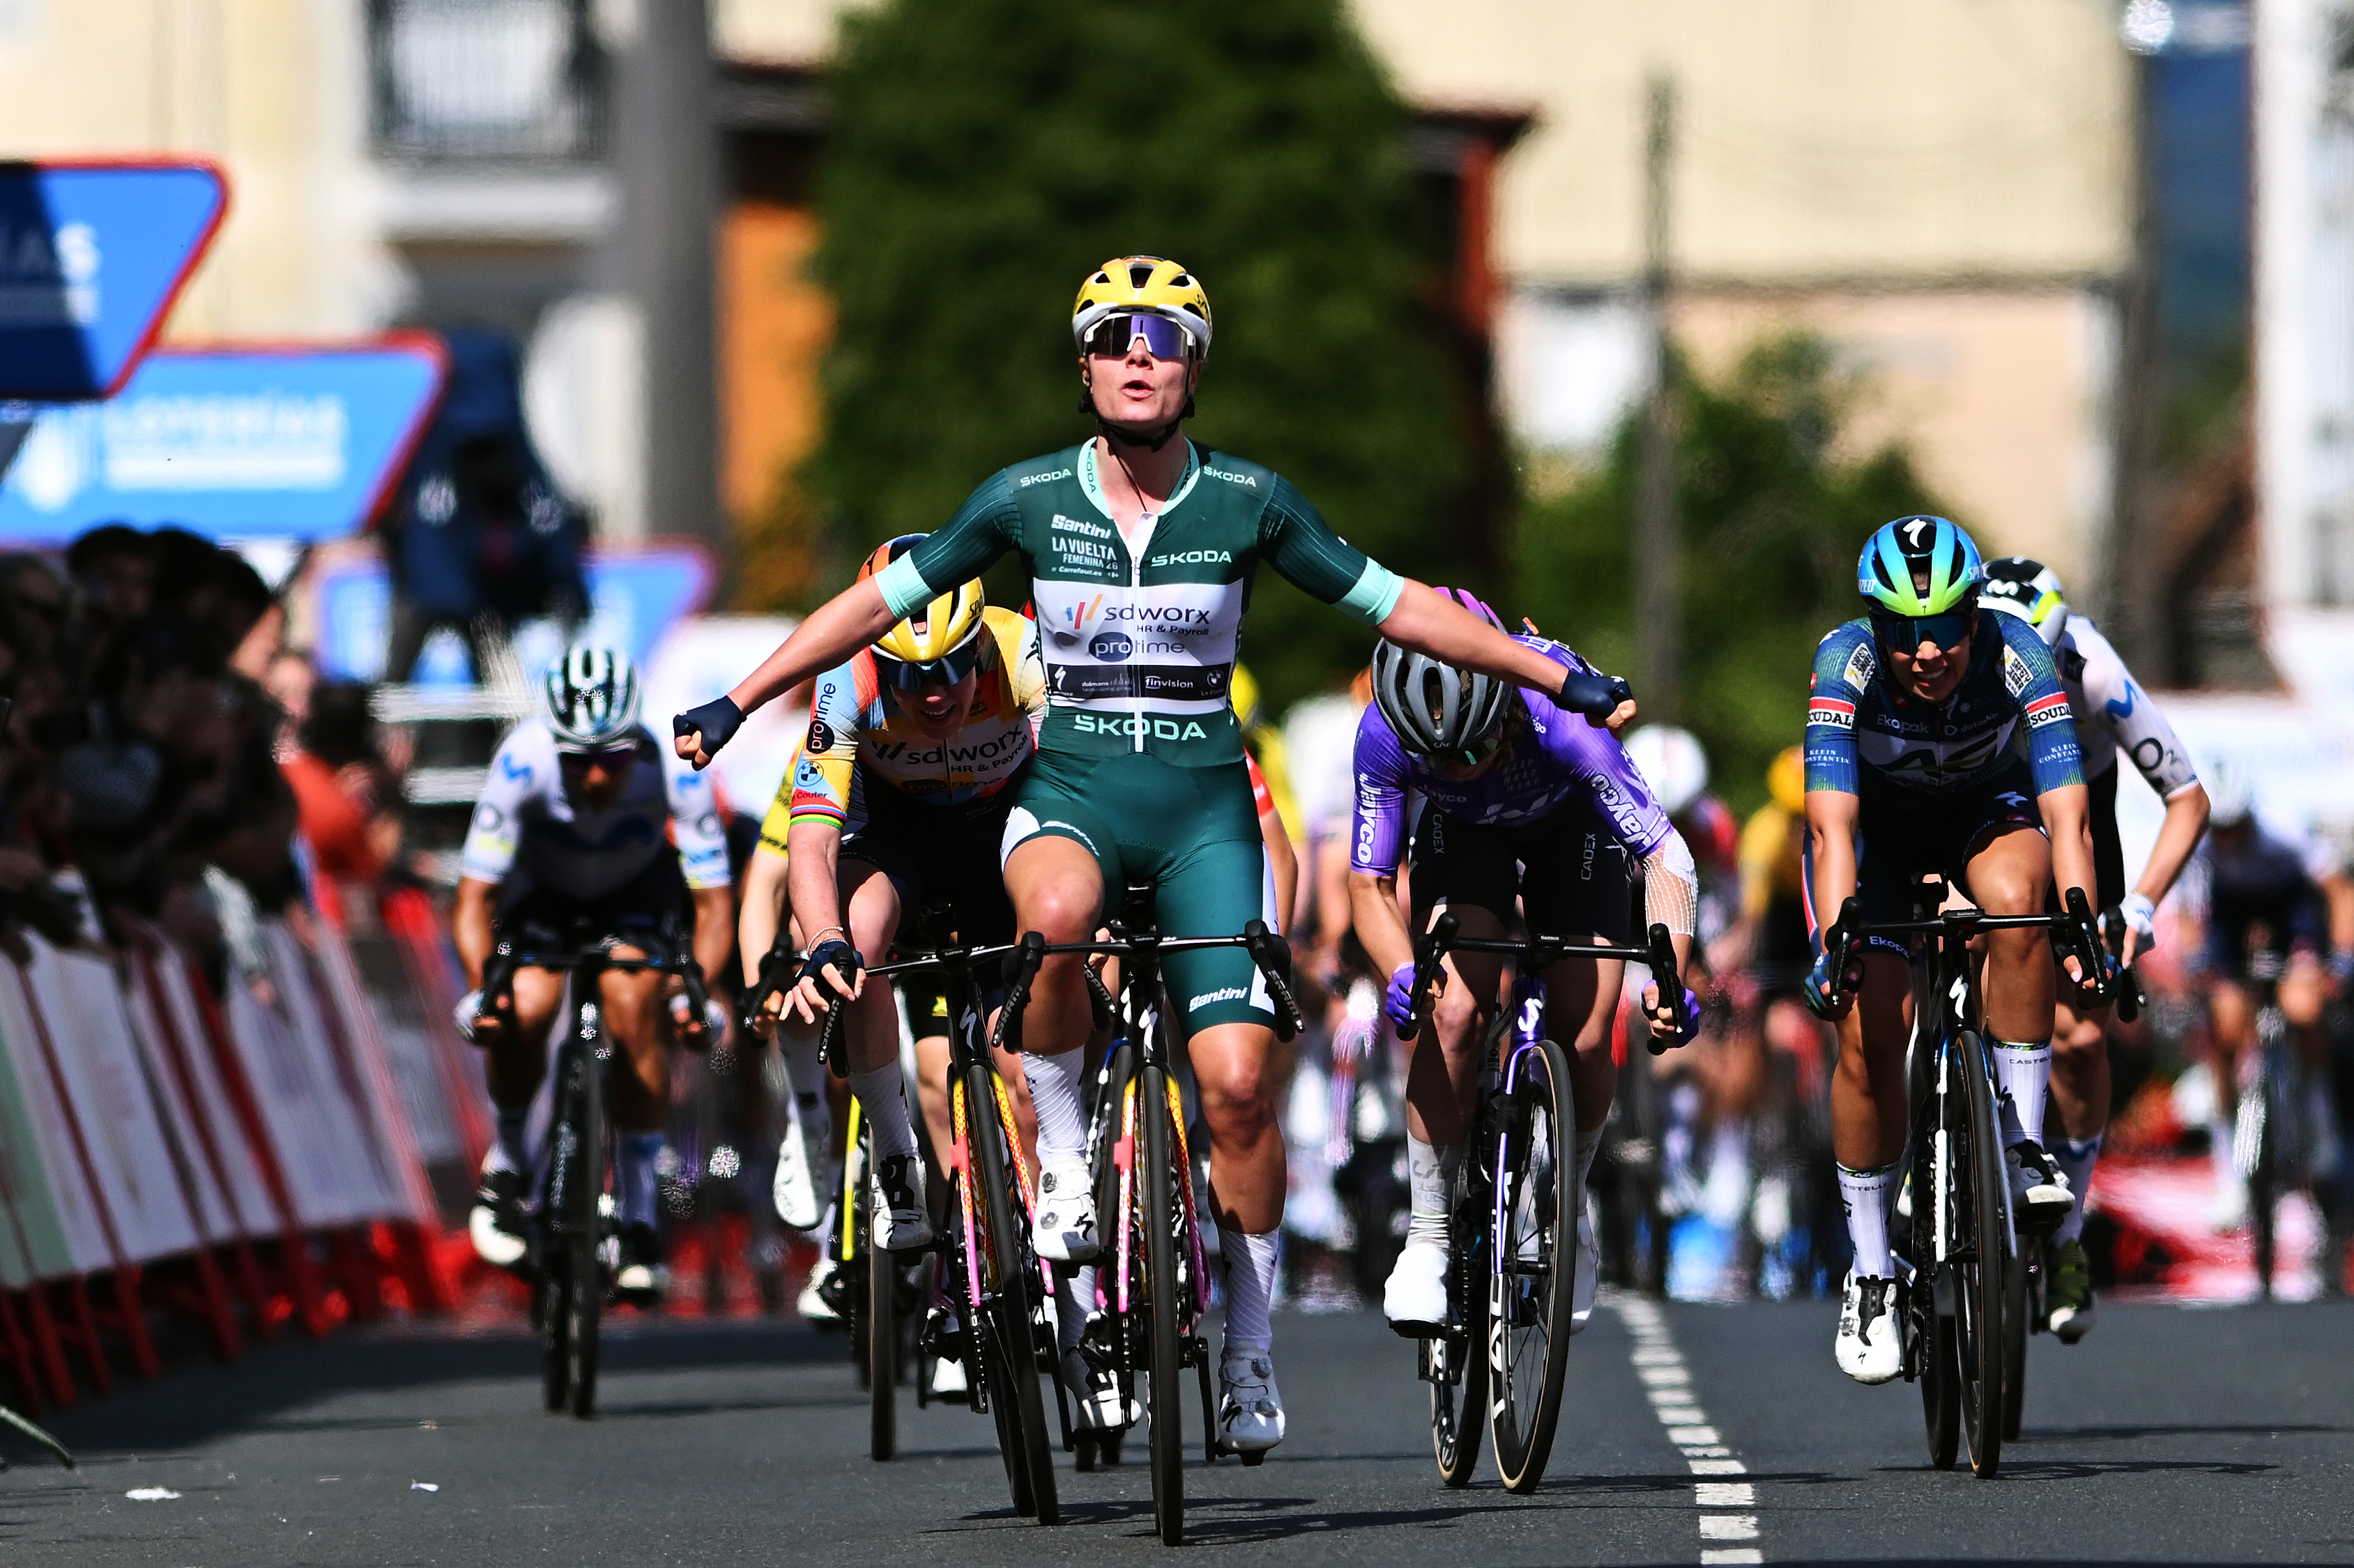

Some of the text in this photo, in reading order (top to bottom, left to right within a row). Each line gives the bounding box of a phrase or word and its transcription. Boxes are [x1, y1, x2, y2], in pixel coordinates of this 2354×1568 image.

[1051, 514, 1111, 539] Santini
[1051, 536, 1117, 561] LA VUELTA
[1063, 553, 1118, 570] FEMENINA 26
[1170, 626, 1209, 636] Payroll
[1095, 640, 1185, 657] protime
[1145, 676, 1193, 689] finvision
[811, 682, 836, 751] protime
[1877, 712, 1998, 734] Ekopak datashift
[2030, 705, 2072, 725] SOUD
[950, 734, 1028, 773] HR & Payroll
[1805, 755, 1849, 764] ONSTANTIA
[2039, 749, 2081, 764] CONSTAN
[2051, 743, 2077, 753] KLEIN
[1419, 785, 1467, 802] Jayco
[1358, 773, 1382, 863] Jayco
[1590, 774, 1653, 847] Jayco
[1432, 813, 1445, 854] CADEX
[1581, 833, 1596, 881] CADEX
[1869, 935, 1910, 960] Ekopa
[996, 985, 1023, 1035] SRAM
[1189, 987, 1248, 1013] Santini
[2010, 1056, 2051, 1065] CASTE
